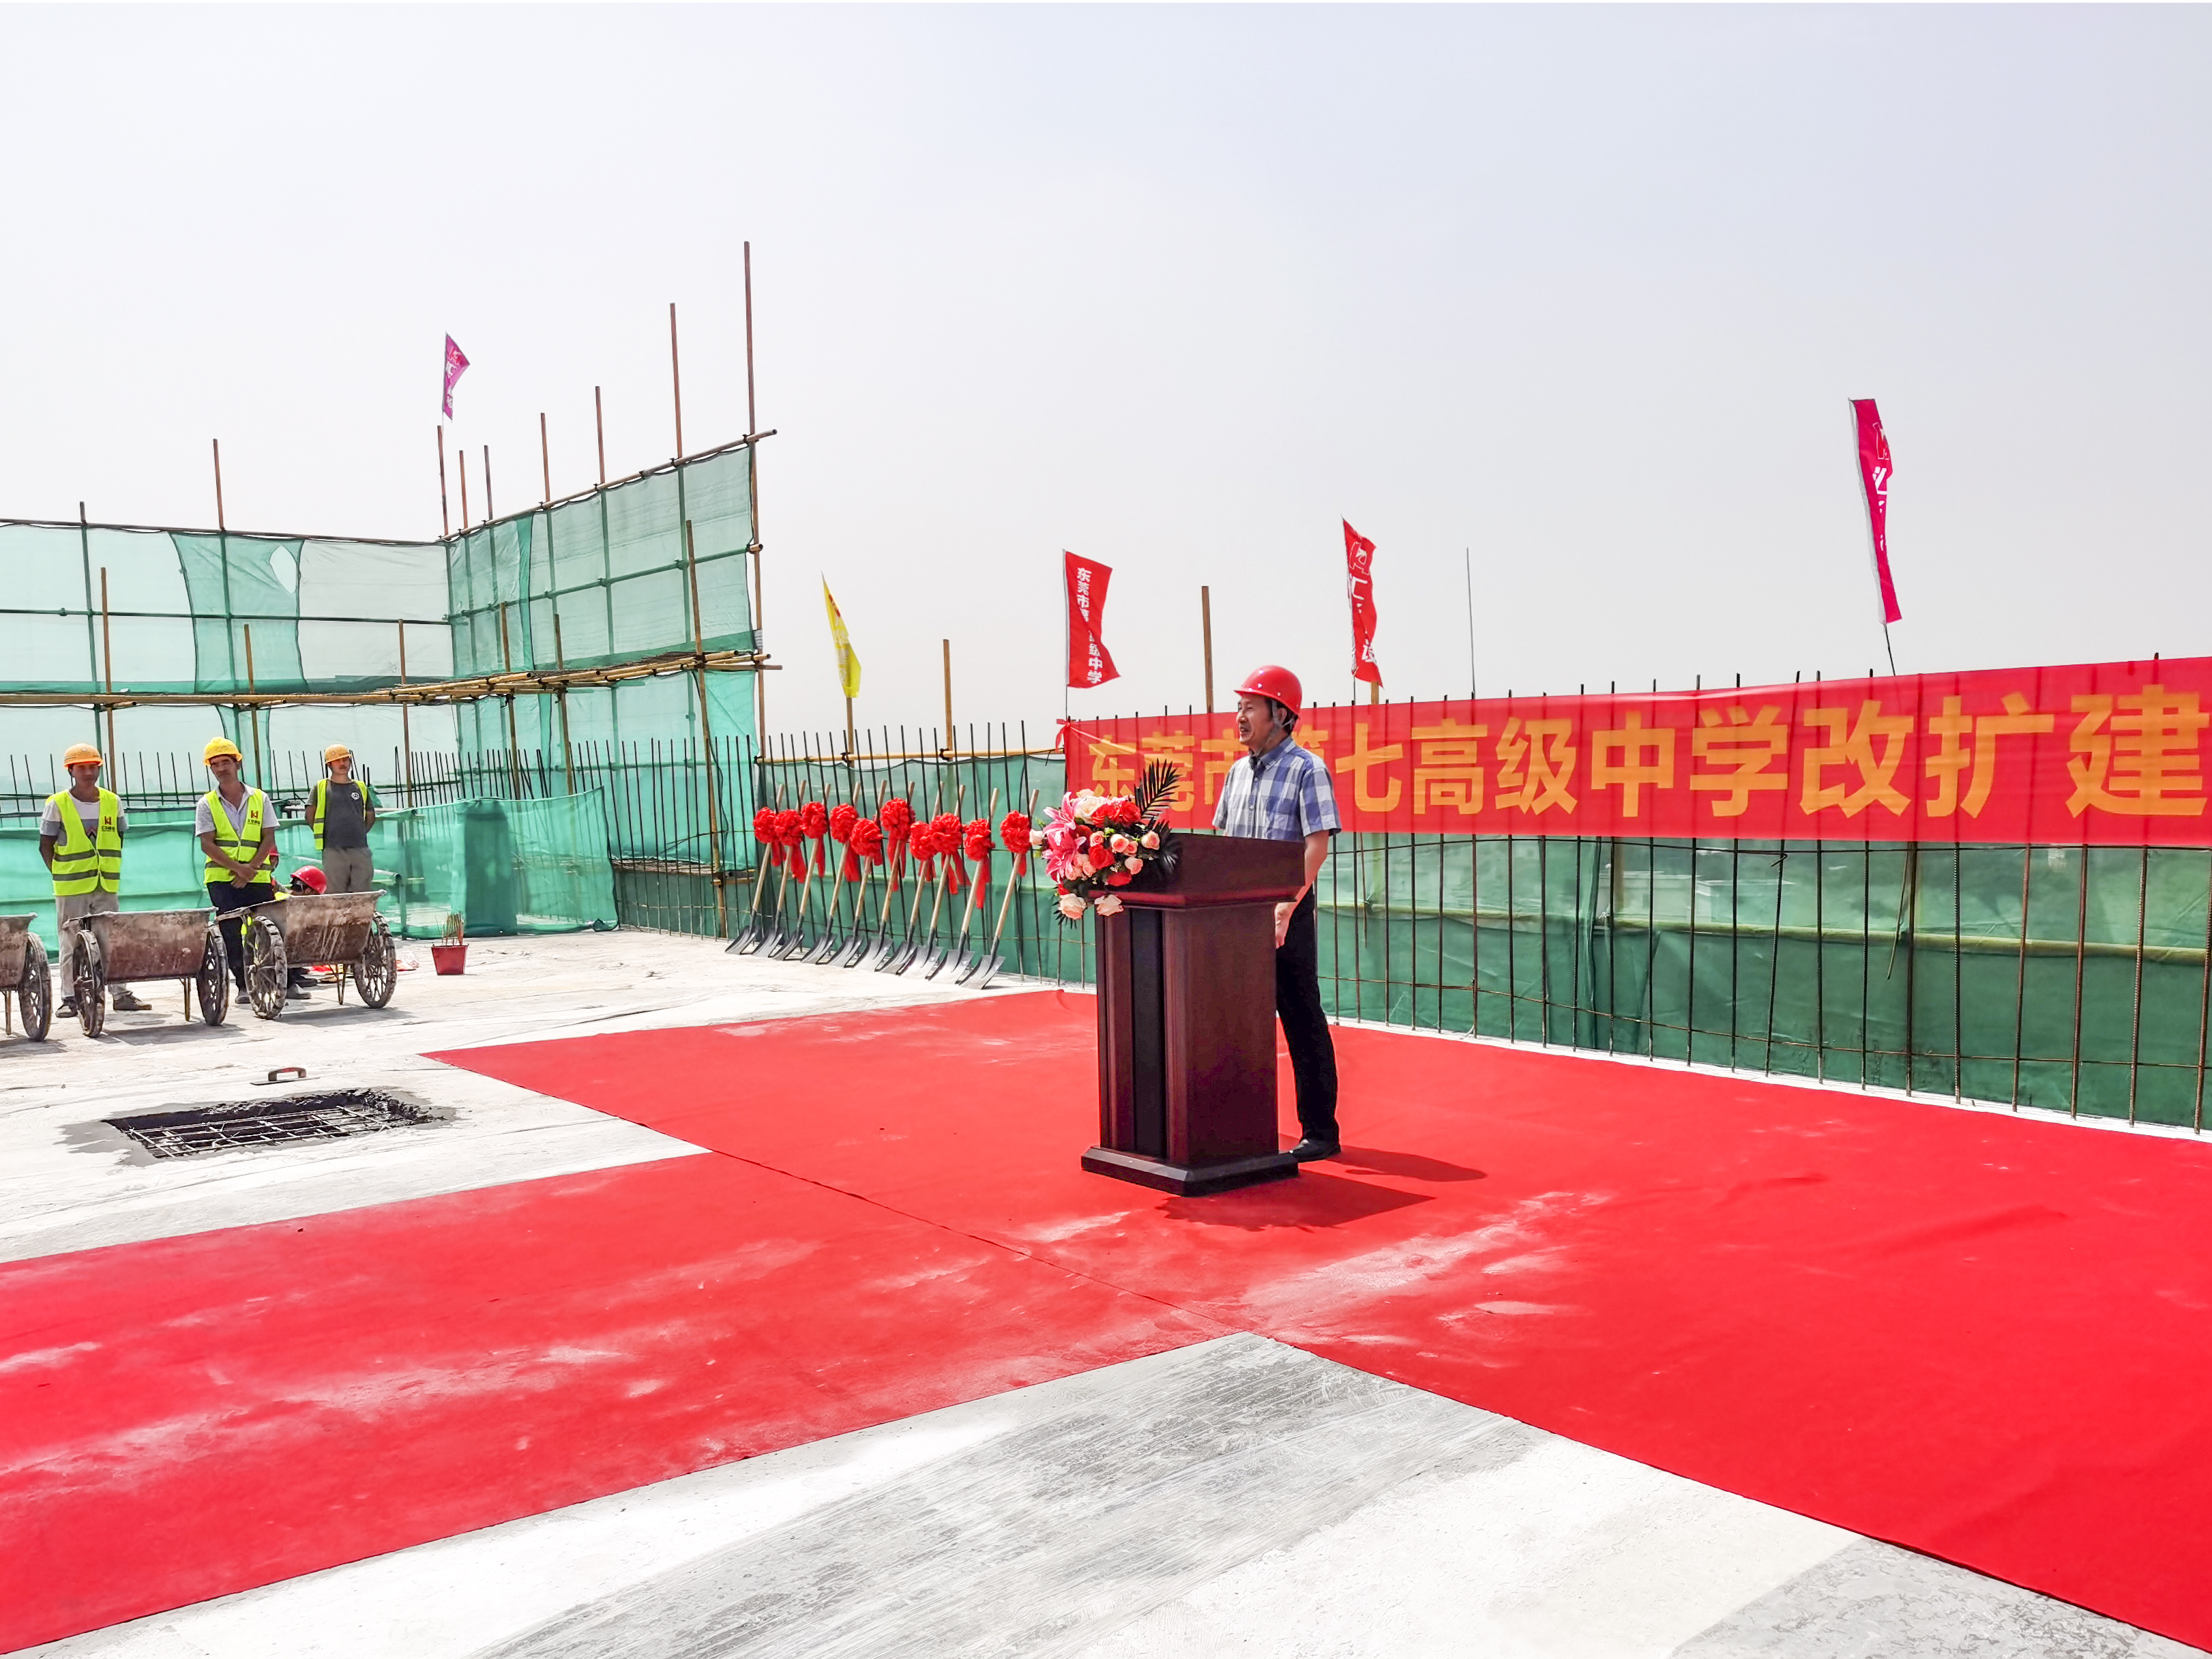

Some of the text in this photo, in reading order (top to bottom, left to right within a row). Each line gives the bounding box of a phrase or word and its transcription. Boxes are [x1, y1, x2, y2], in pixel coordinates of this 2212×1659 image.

[1089, 684, 2210, 819] 东莞市七高级中学改扩建
